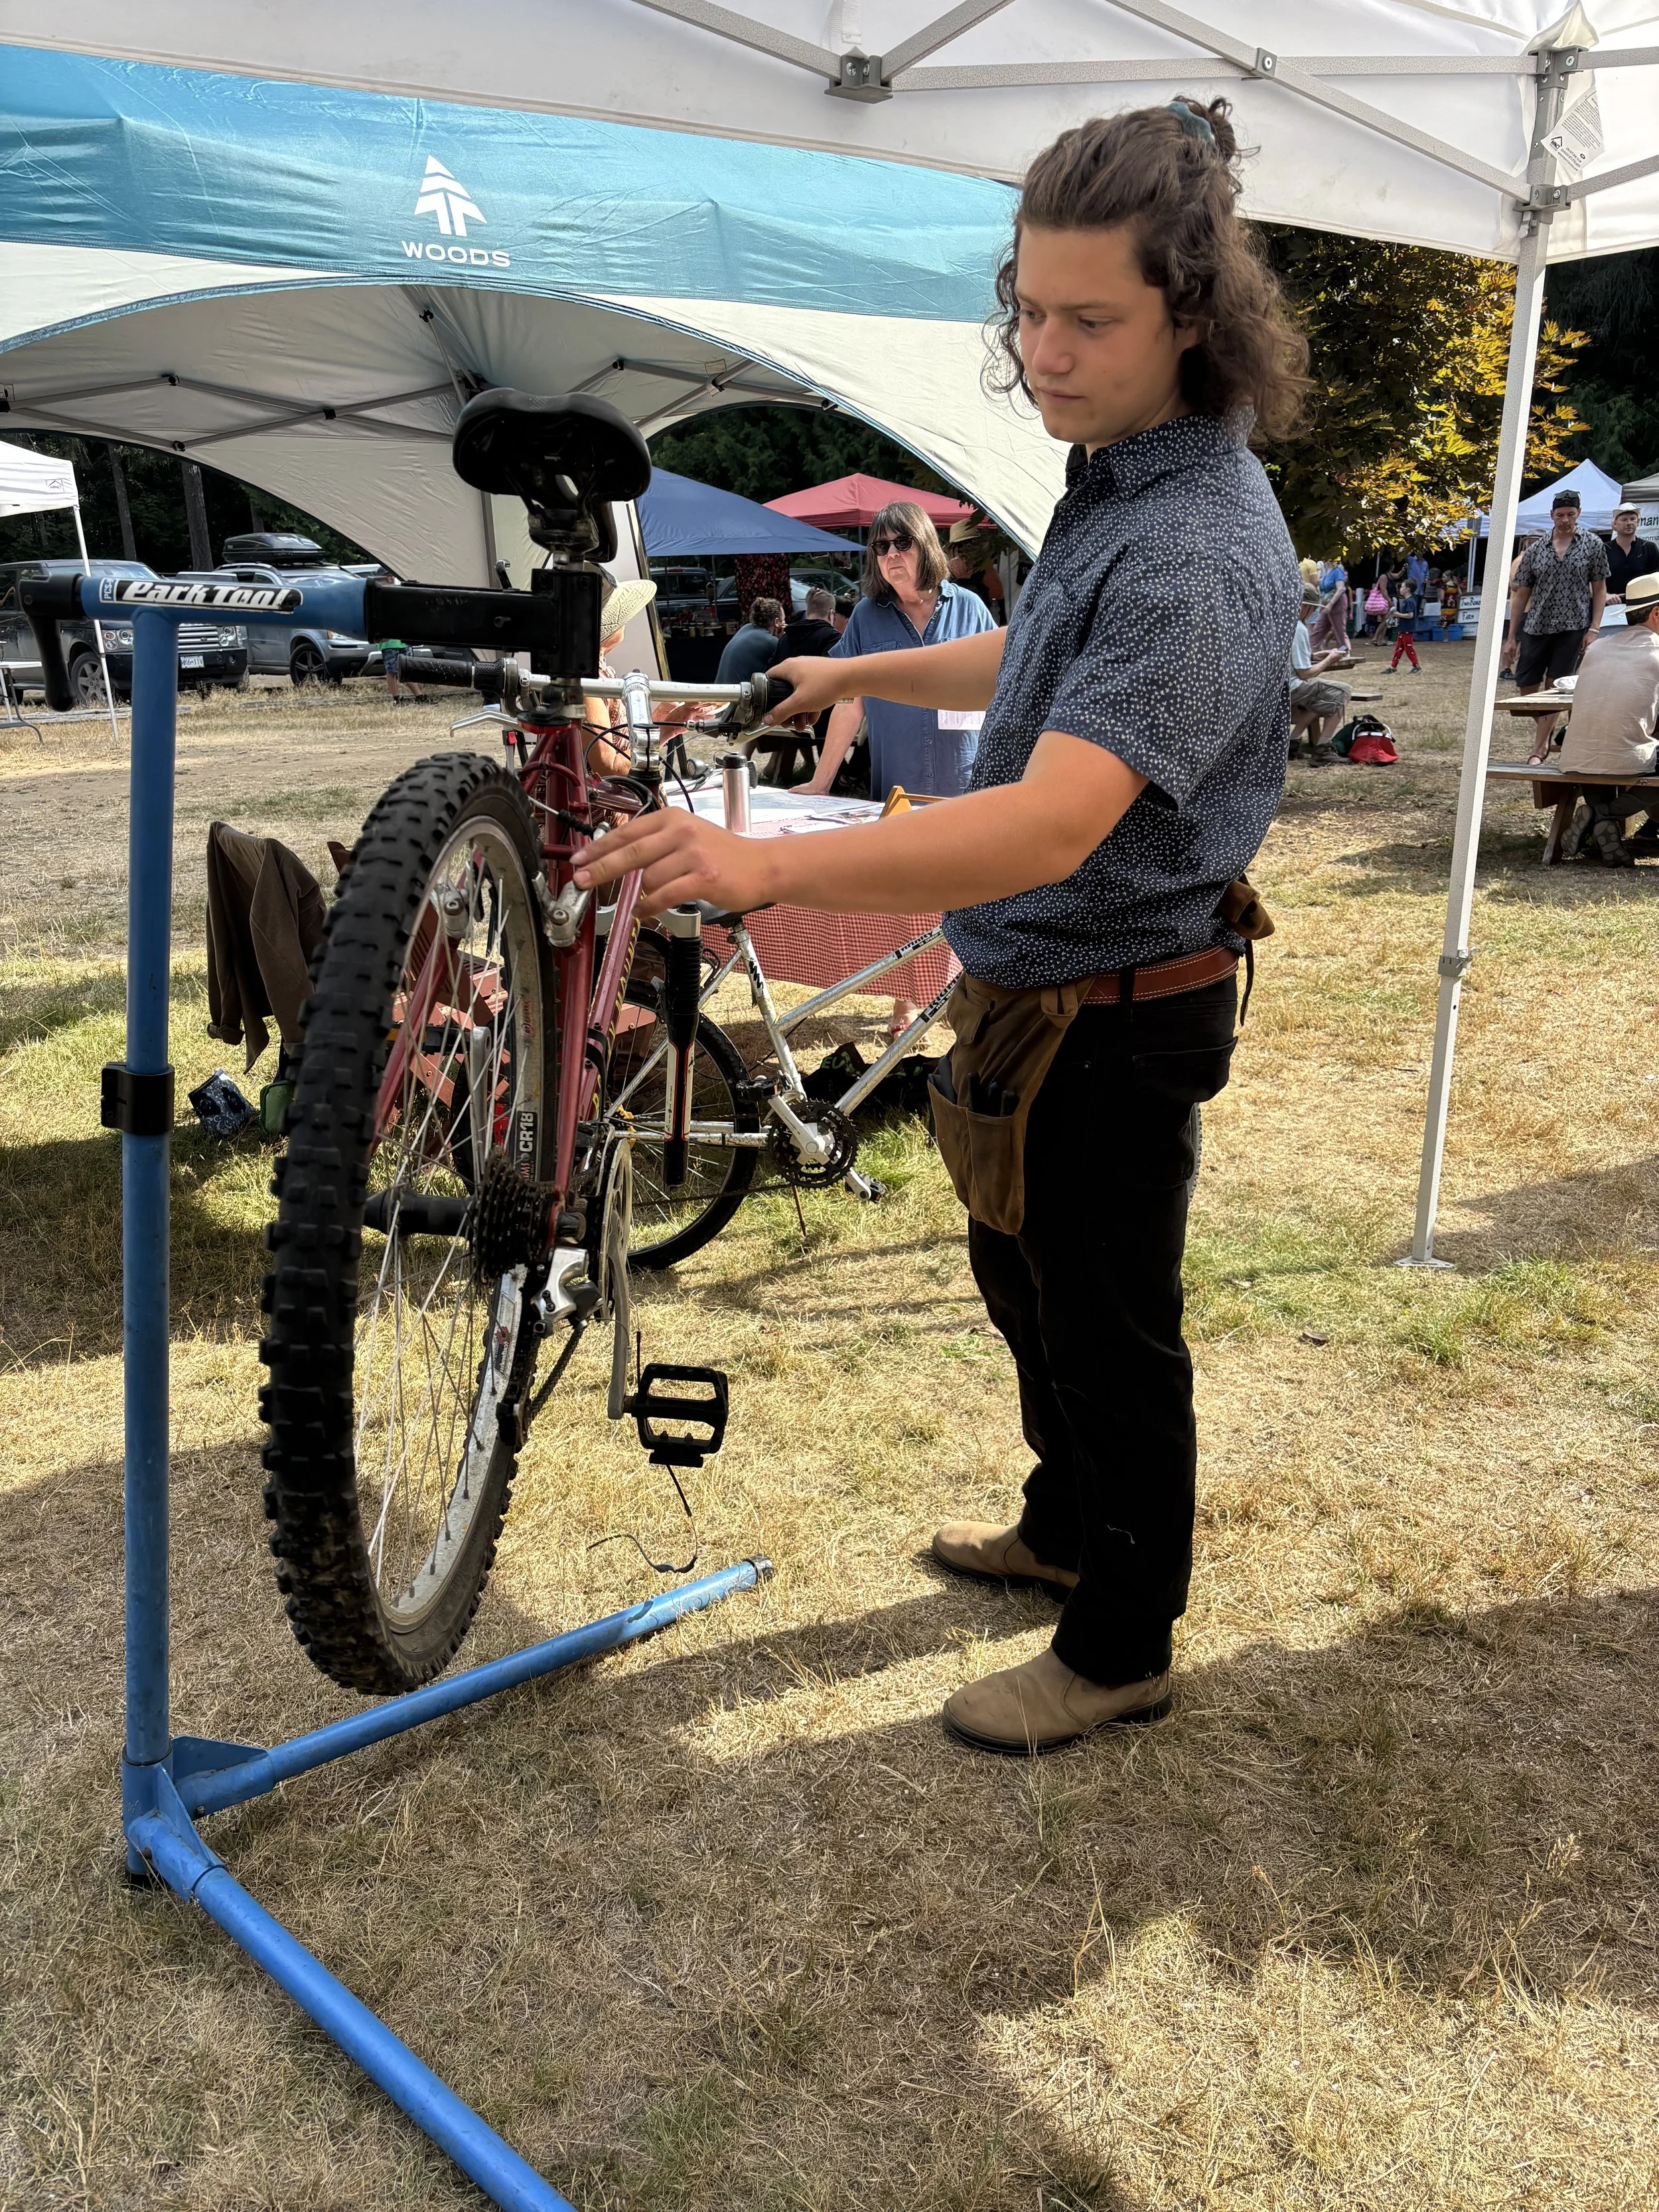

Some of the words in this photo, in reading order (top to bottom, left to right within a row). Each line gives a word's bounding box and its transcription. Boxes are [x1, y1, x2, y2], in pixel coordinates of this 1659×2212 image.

[401, 240, 510, 267] WOODS
[122, 581, 208, 605] Park
[211, 585, 291, 609] Tool
[519, 1112, 534, 1152] CR18
